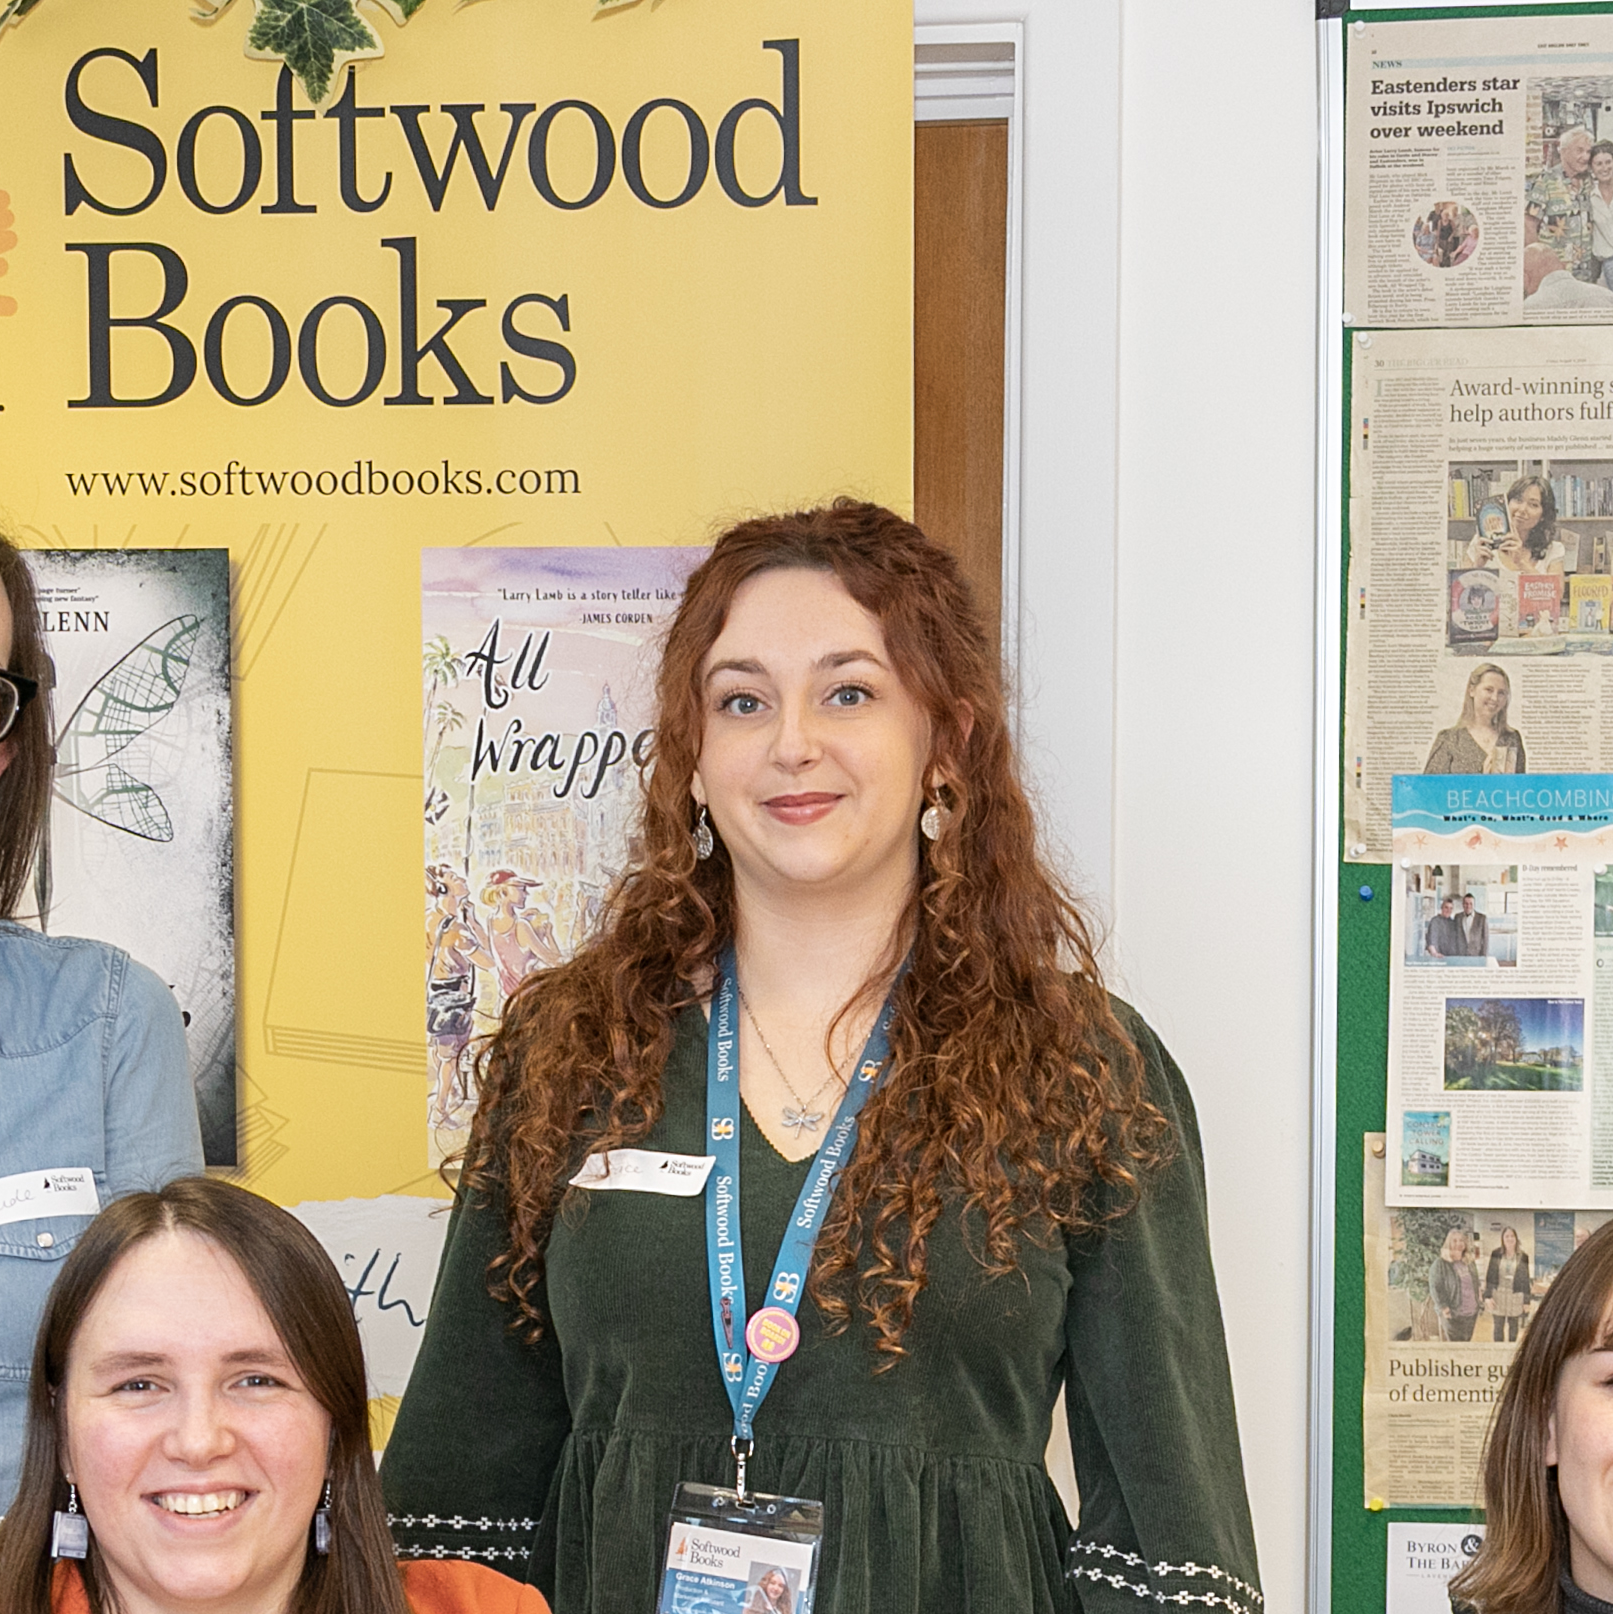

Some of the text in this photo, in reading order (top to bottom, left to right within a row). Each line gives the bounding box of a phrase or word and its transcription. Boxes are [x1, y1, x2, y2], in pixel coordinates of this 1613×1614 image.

[1372, 60, 1402, 68] NEWS
[1371, 76, 1520, 94] Eastenders star
[1371, 99, 1503, 118] visits Ipswich
[63, 40, 817, 216] Softwood
[1370, 120, 1503, 139] over weekend
[65, 237, 579, 408] Books
[1450, 377, 1605, 399] Award-winning
[1448, 404, 1493, 427] help
[1498, 403, 1575, 422] authors
[65, 459, 582, 498] www.softwoodbooks.com
[567, 589, 576, 600] is
[591, 589, 618, 602] story
[622, 588, 651, 600] teller
[656, 588, 677, 600] like
[42, 611, 109, 631] LENN
[615, 613, 653, 624] CORDEN
[465, 618, 550, 709] All
[471, 718, 658, 798] Wrappe
[716, 977, 733, 1083] Softwood Books
[797, 1115, 855, 1229] Softwood Books
[715, 1176, 734, 1248] Softwood
[1389, 1358, 1482, 1377] Publisher
[1389, 1384, 1409, 1402] of
[690, 1538, 741, 1558] Softwood
[690, 1552, 724, 1568] Books
[675, 1572, 735, 1589] Grace Atkinson
